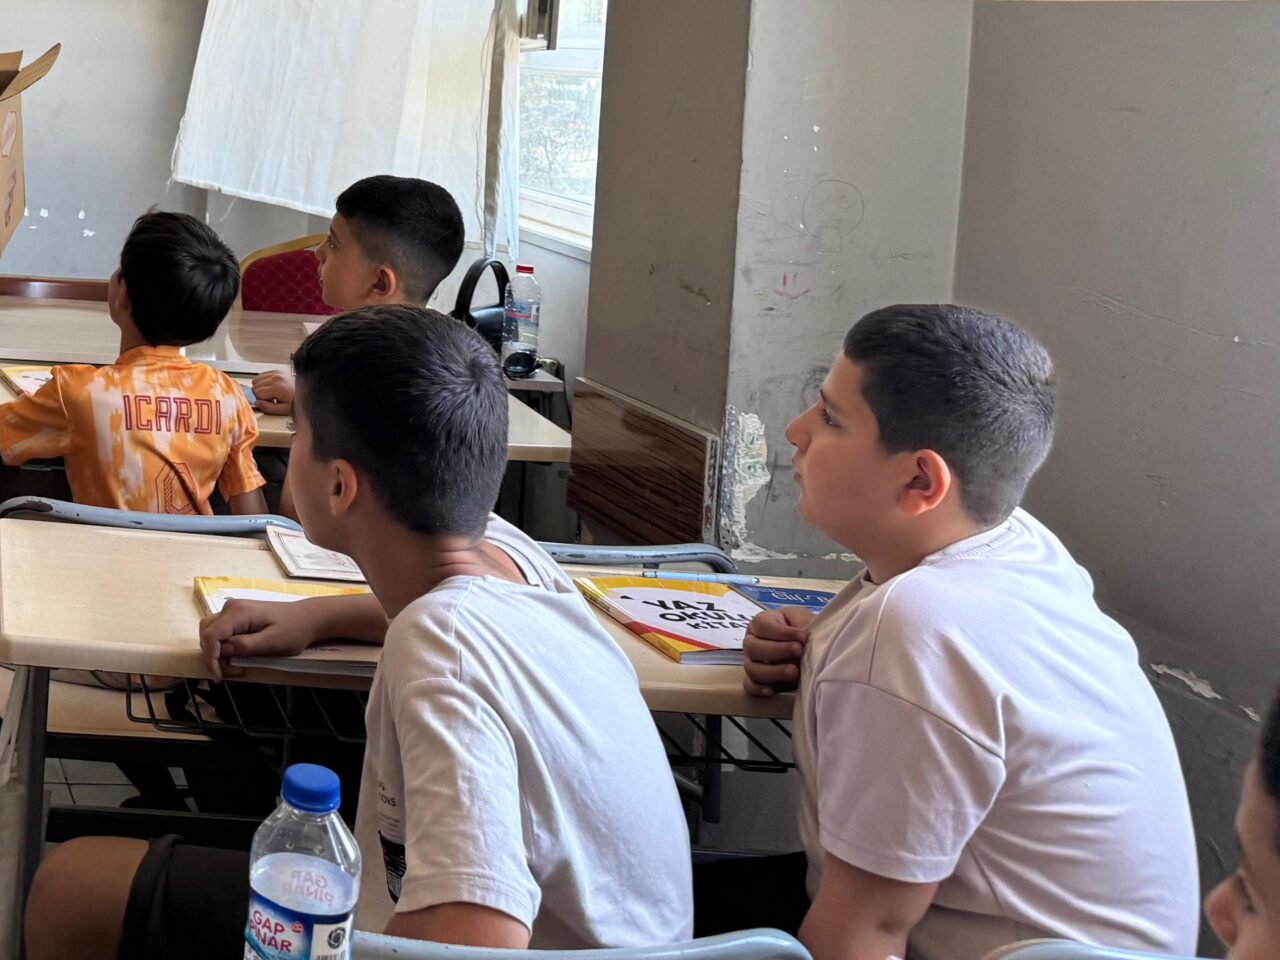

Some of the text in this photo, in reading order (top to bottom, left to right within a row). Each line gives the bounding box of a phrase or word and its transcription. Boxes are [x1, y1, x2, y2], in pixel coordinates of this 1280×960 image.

[122, 394, 222, 435] ICARDI
[642, 599, 727, 613] YAZ
[249, 919, 293, 953] PINAR
[253, 910, 285, 936] GAP
